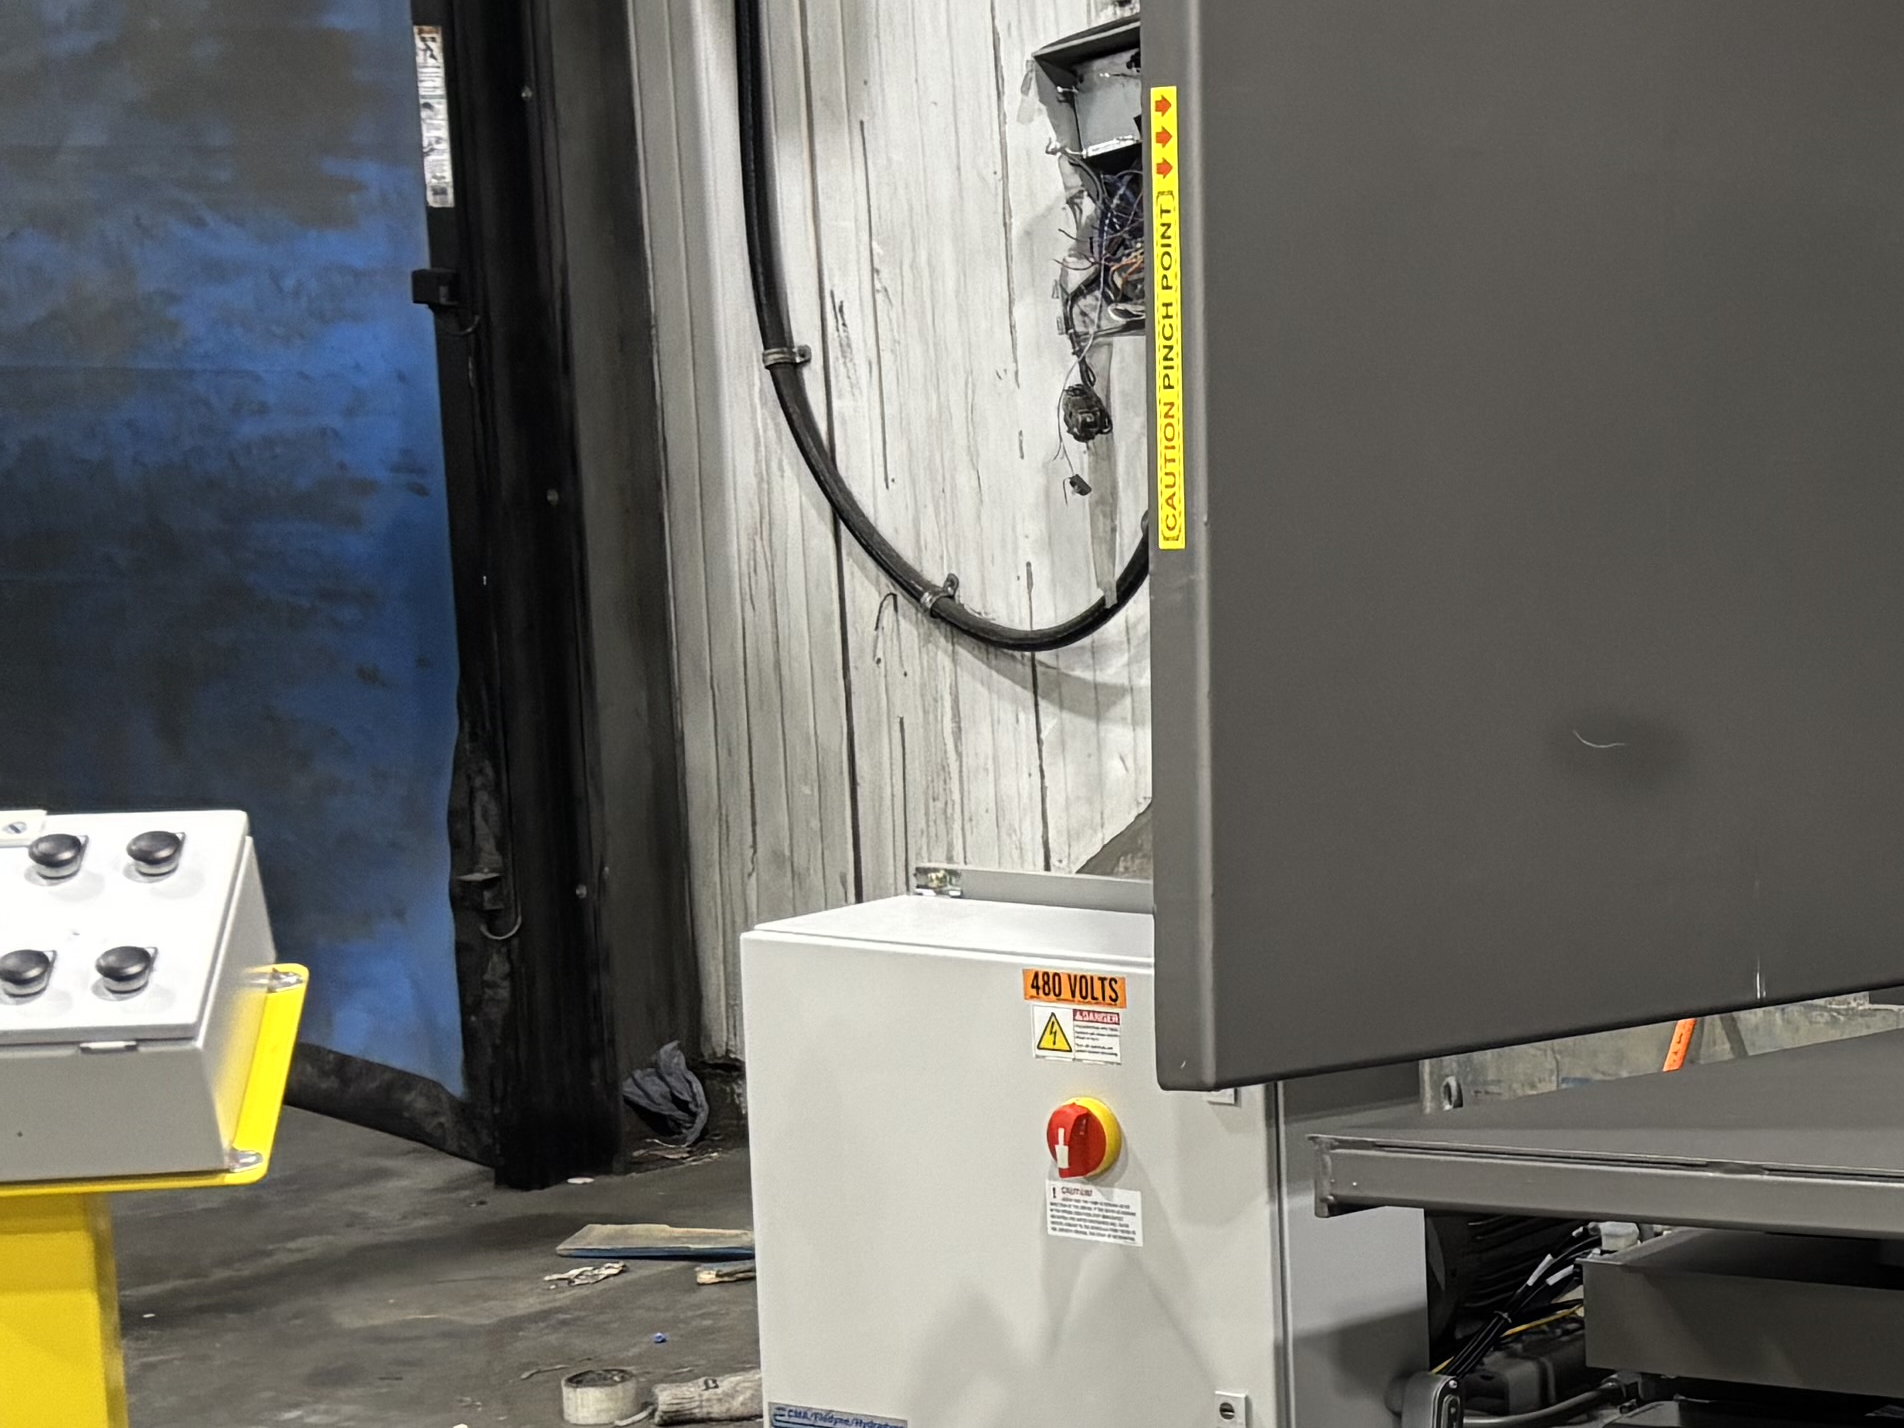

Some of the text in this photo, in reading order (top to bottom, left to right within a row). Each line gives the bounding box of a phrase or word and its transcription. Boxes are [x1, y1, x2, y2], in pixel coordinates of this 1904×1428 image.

[1159, 204, 1177, 532] CAUTION PINCH POINT
[1030, 970, 1119, 1004] 480 VOLTS
[1082, 1011, 1119, 1024] DANGER
